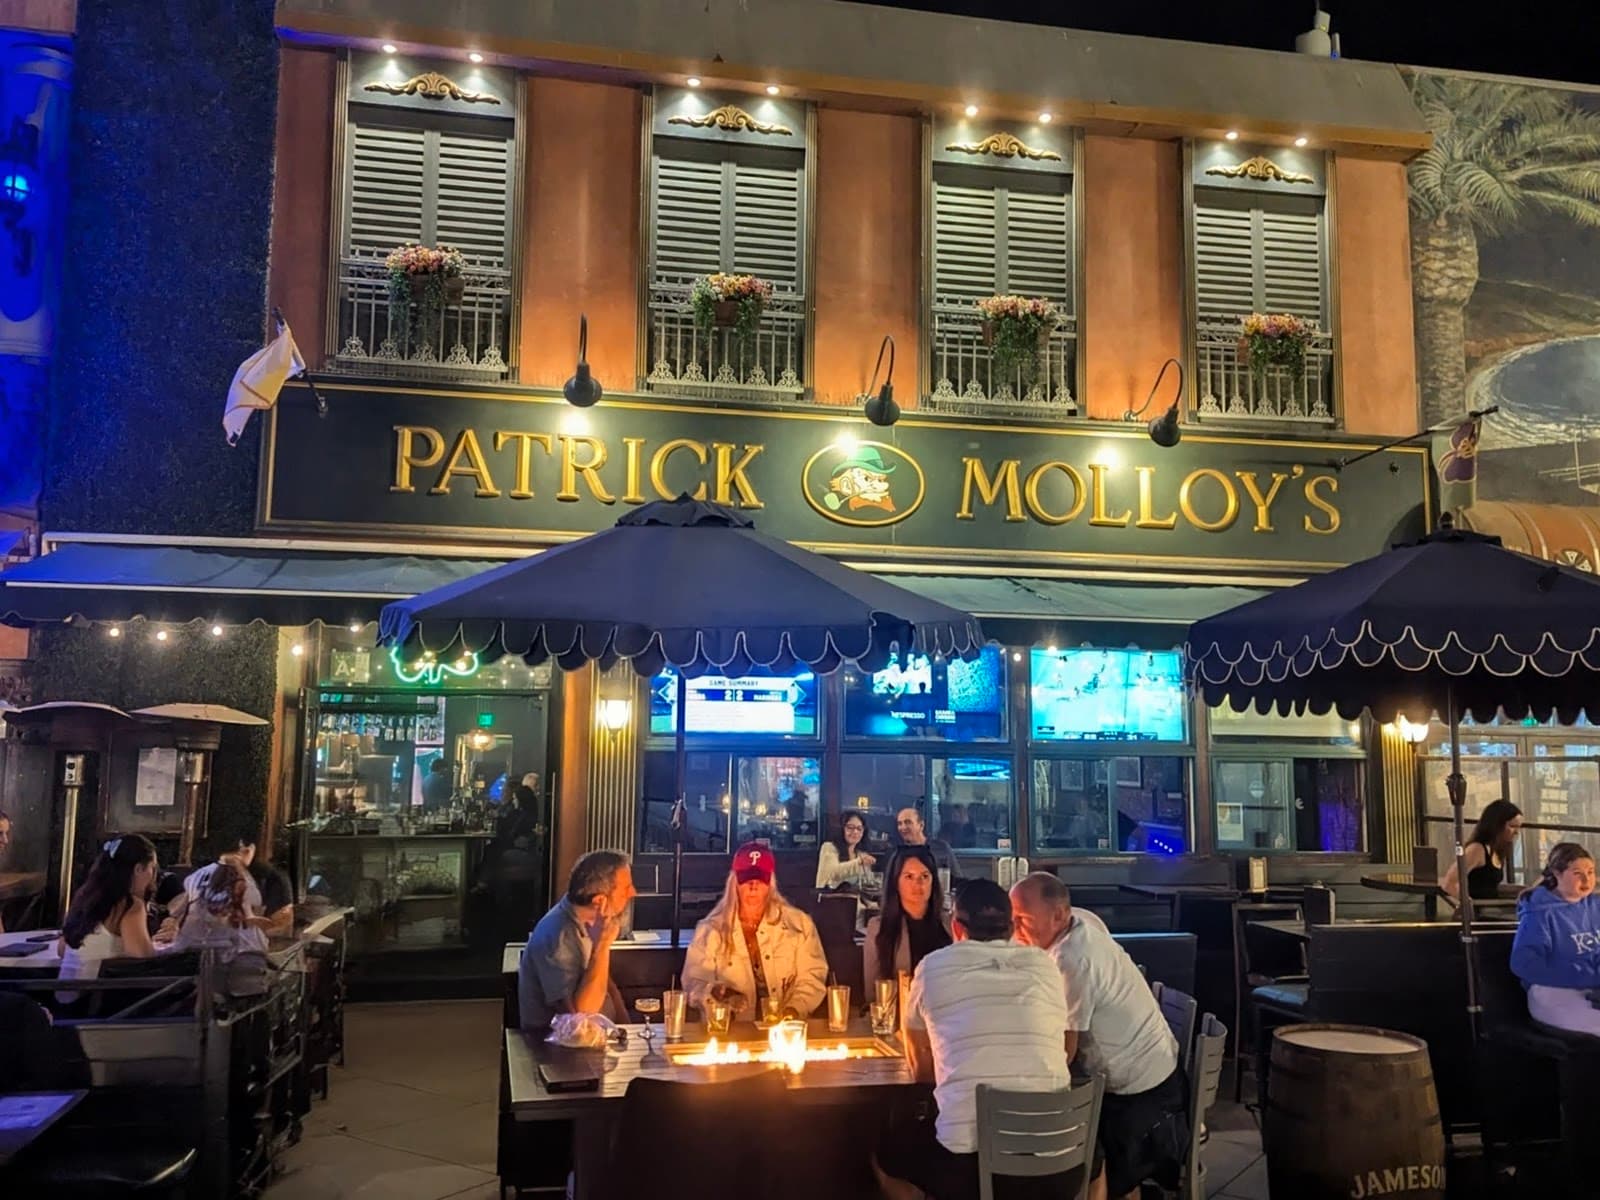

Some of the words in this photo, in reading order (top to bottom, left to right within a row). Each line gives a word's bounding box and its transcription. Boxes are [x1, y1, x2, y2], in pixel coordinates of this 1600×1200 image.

[389, 424, 765, 509] PATRICK
[956, 456, 1342, 534] MOLLOY'S
[724, 690, 732, 701] 2
[736, 690, 744, 701] 2
[749, 850, 762, 866] P
